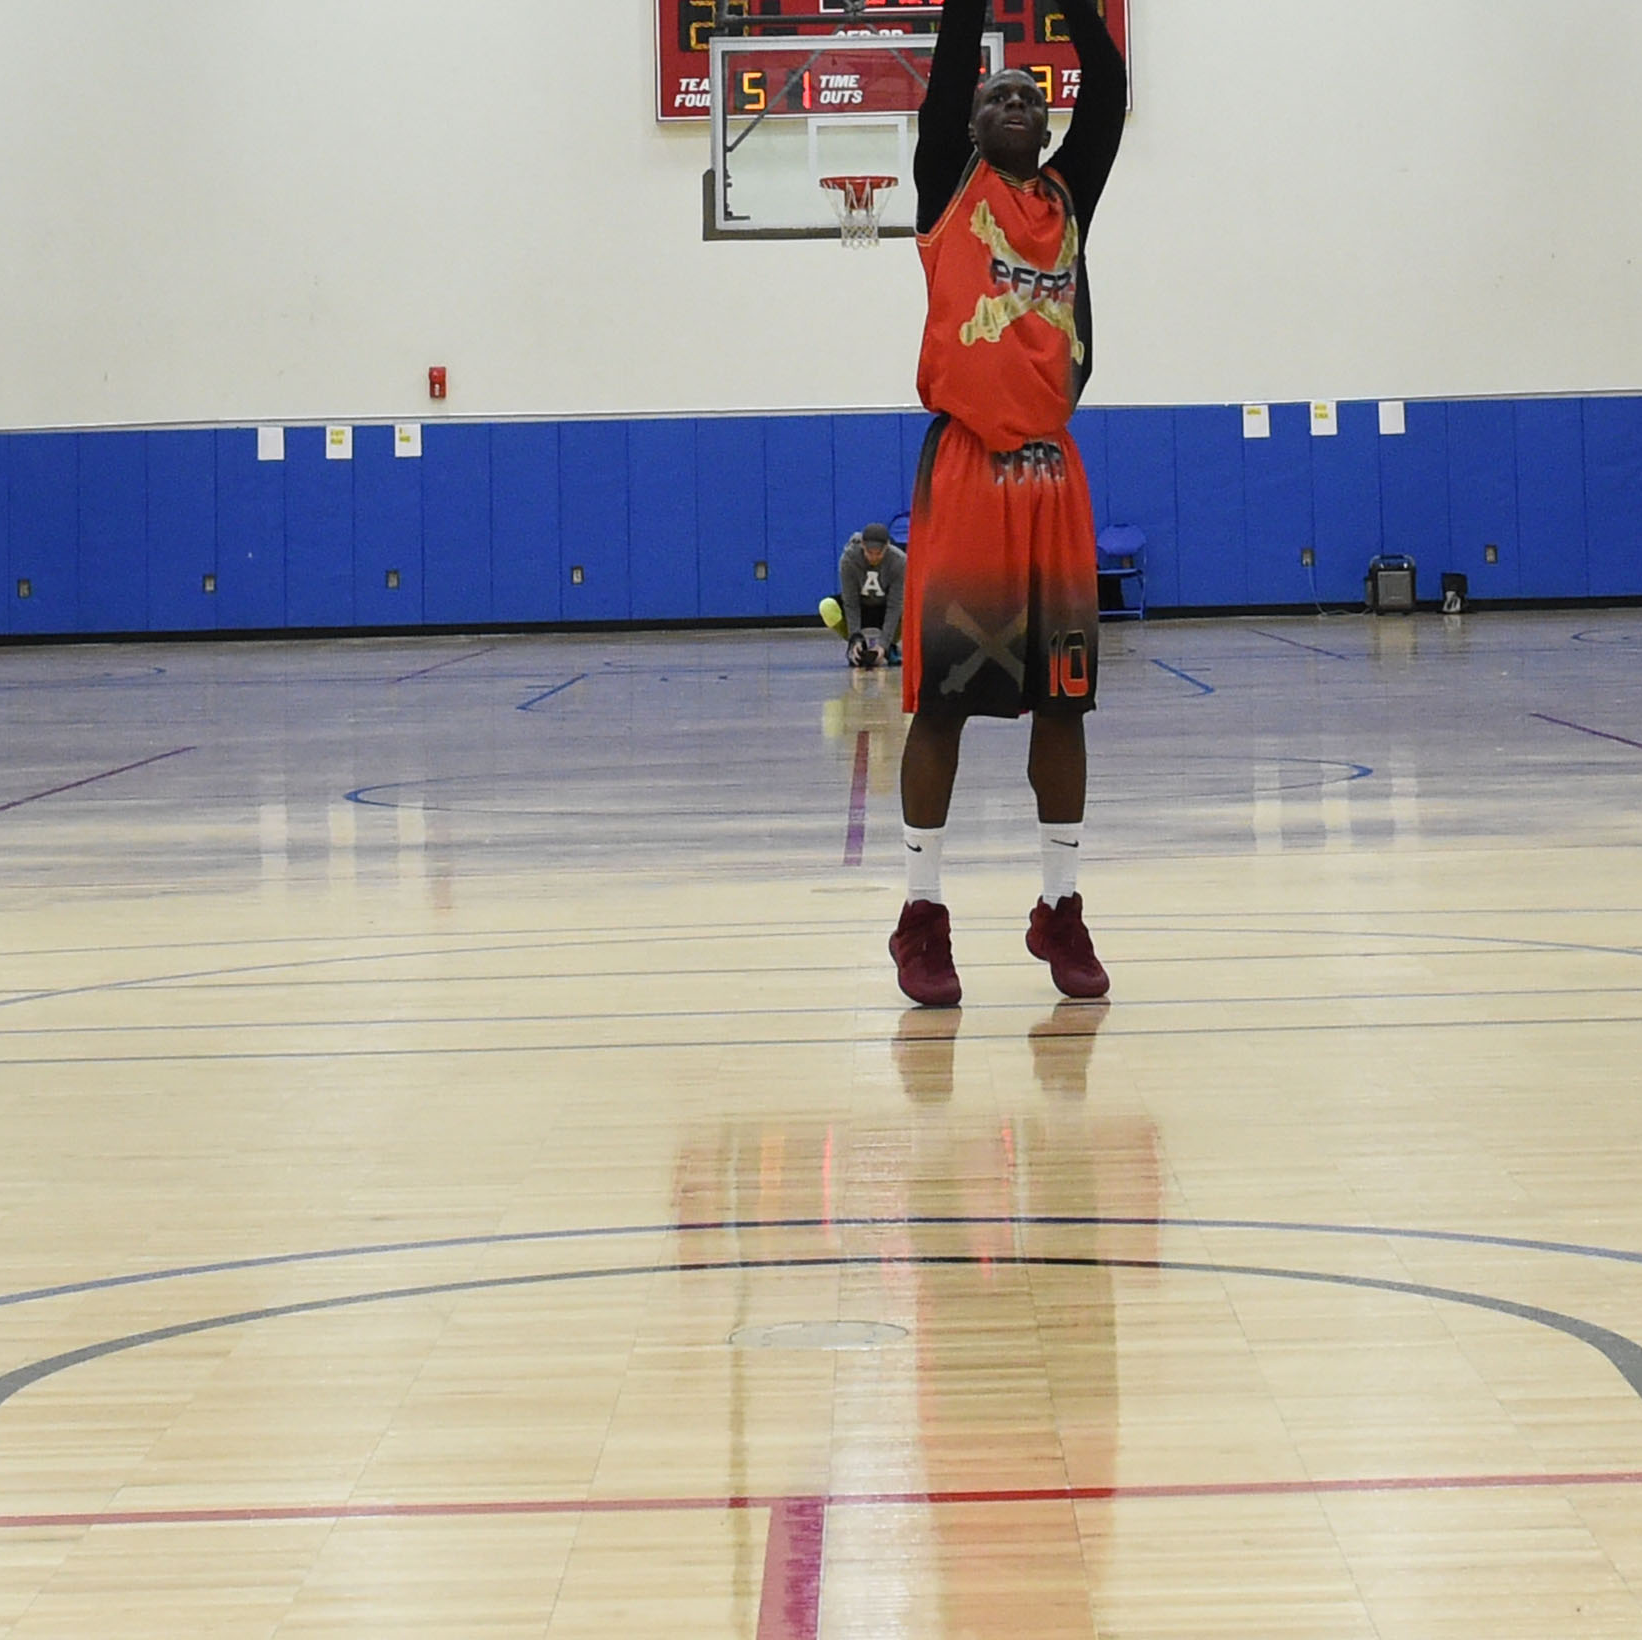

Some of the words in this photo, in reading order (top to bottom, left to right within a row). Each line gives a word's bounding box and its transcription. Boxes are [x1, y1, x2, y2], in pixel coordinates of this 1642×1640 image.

[742, 71, 766, 110] 5
[802, 71, 812, 109] 1
[819, 74, 861, 88] TIME
[819, 89, 863, 104] OUTS
[861, 570, 885, 596] A
[1049, 629, 1089, 697] 10
